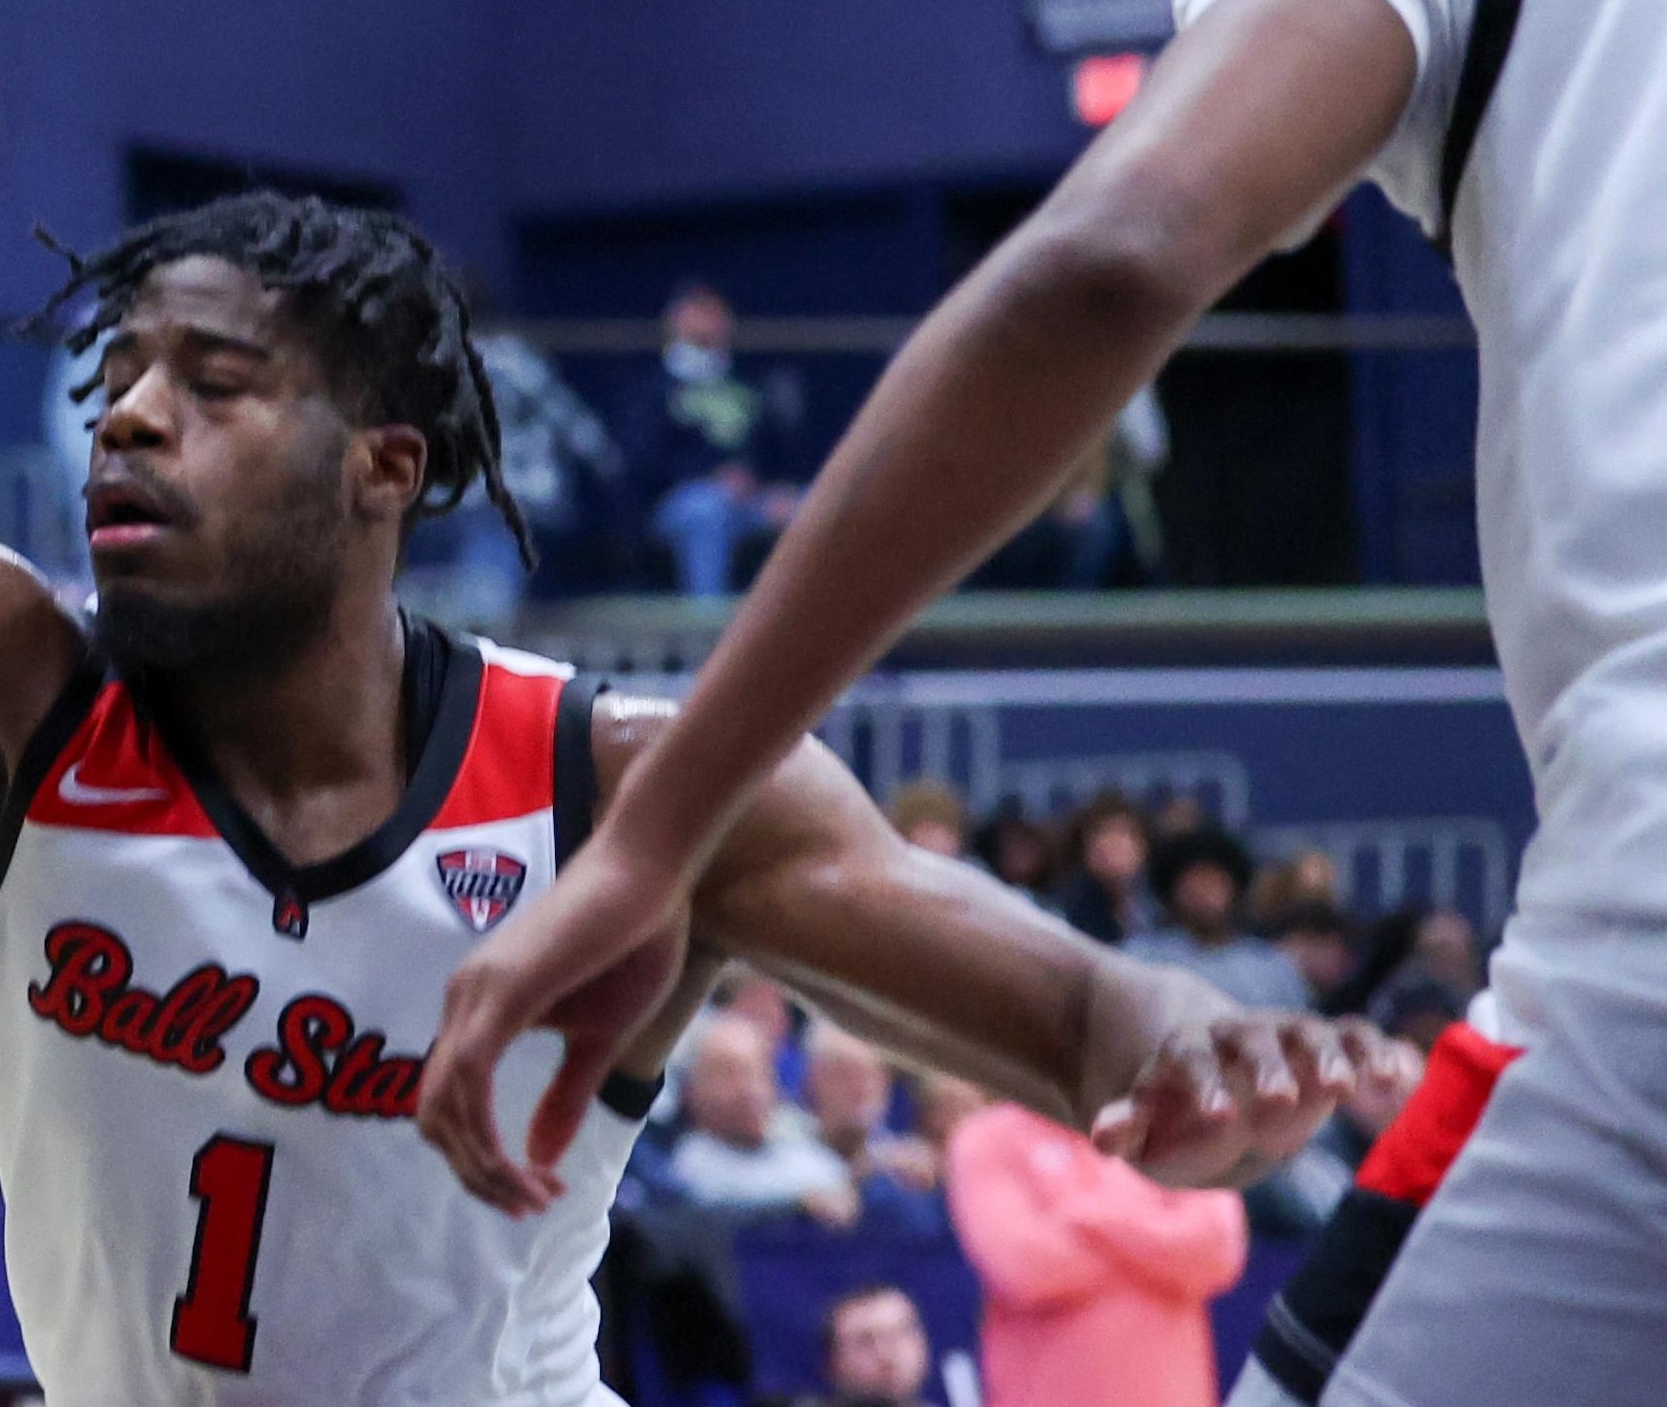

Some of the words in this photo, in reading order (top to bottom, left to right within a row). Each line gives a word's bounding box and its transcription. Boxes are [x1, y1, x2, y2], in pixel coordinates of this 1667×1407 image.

[28, 919, 260, 1077] Ball
[244, 994, 427, 1119] Sta
[170, 1132, 274, 1374] 1
